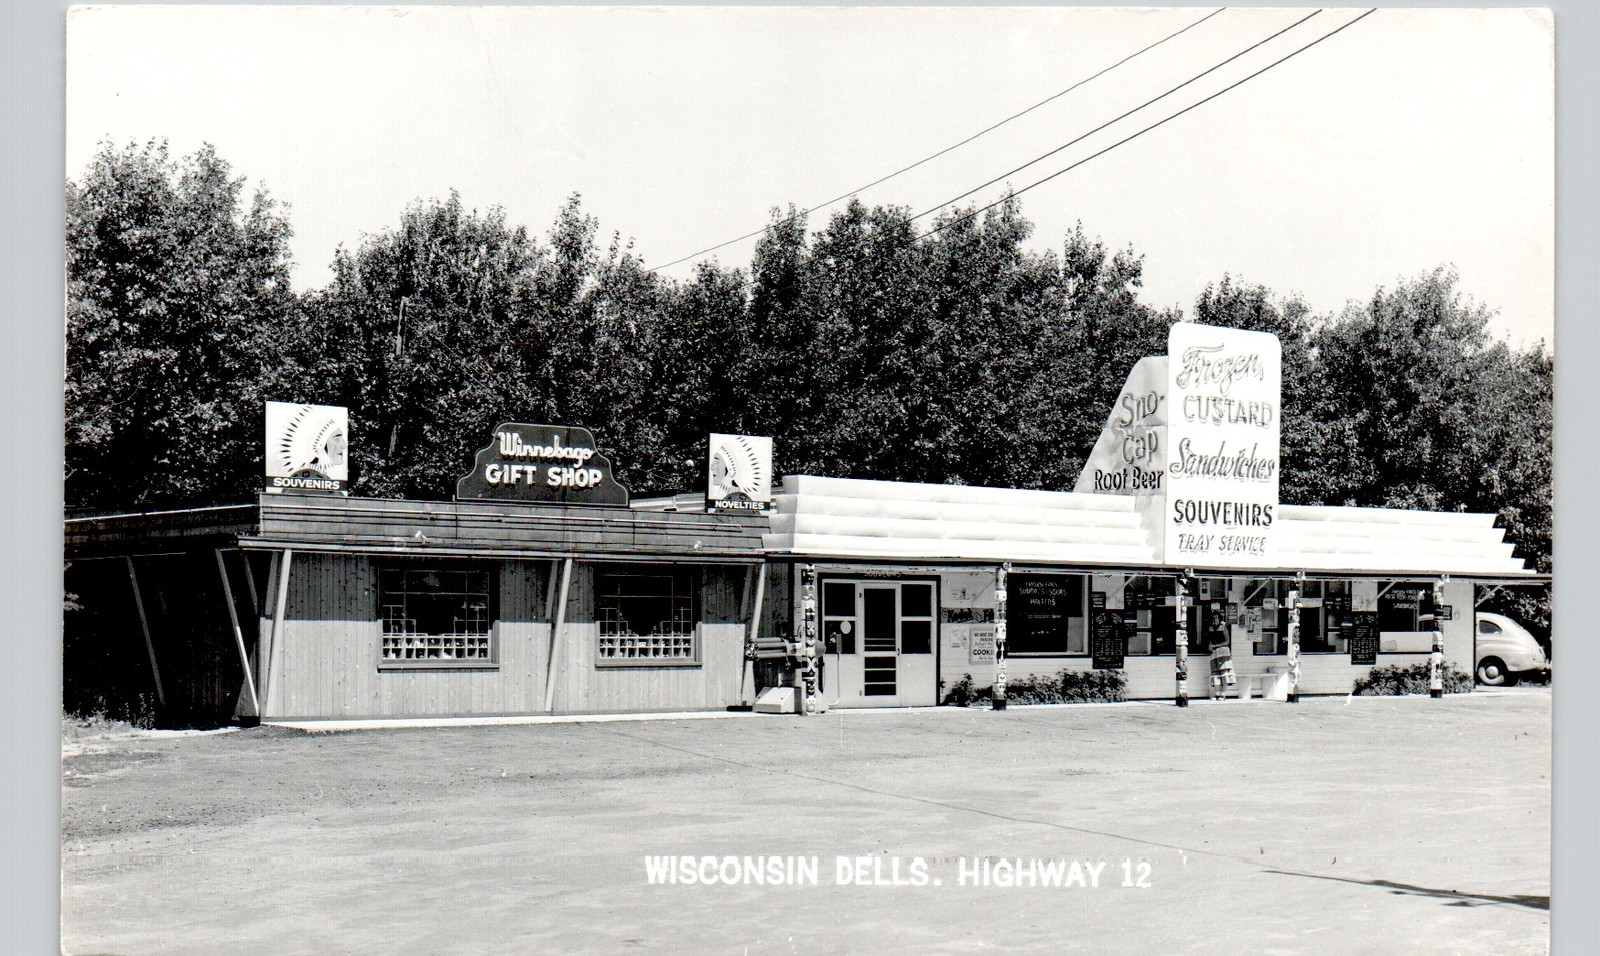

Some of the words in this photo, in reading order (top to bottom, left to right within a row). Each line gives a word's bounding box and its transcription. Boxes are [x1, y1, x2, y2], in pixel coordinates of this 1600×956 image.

[1176, 343, 1264, 397] Frozen
[1183, 395, 1273, 429] CUSTARD
[498, 432, 595, 468] Winnebago
[1169, 437, 1276, 482] Sandwiches
[273, 477, 340, 490] SOUVENIRS
[485, 463, 537, 485] GIFT
[546, 466, 603, 487] SHOP
[1094, 469, 1129, 491] Root
[1133, 467, 1164, 490] Beer
[715, 500, 765, 510] NOVELTIES
[1173, 499, 1273, 527] SOUVENIRS
[1178, 533, 1215, 552] TRAY
[1219, 534, 1268, 555] SERVICE
